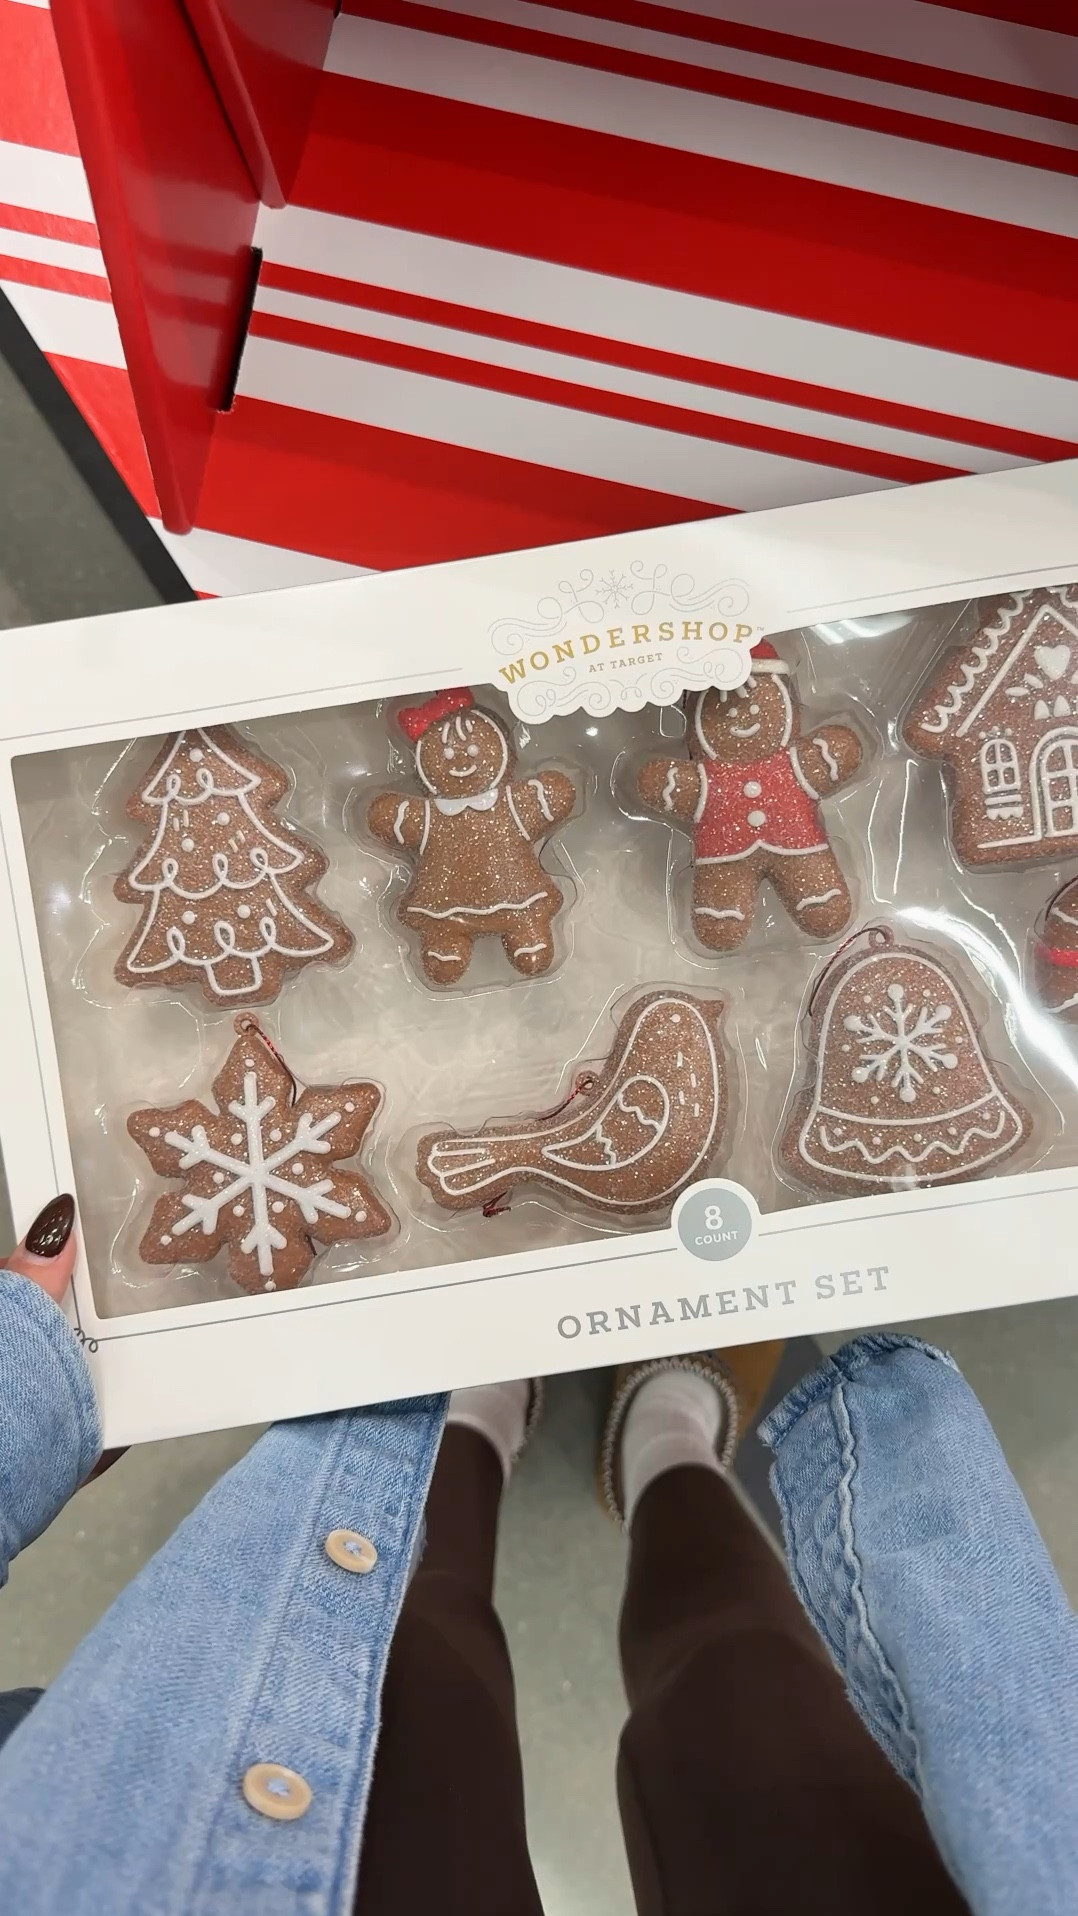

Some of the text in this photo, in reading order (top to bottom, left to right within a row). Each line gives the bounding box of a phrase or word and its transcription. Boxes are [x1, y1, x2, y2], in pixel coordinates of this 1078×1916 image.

[499, 621, 753, 685] WONDERSHOP
[588, 652, 663, 673] AT TARGET
[703, 1205, 724, 1230] 8
[694, 1230, 738, 1246] COUNT
[557, 1266, 889, 1339] ORNAMENT SET
